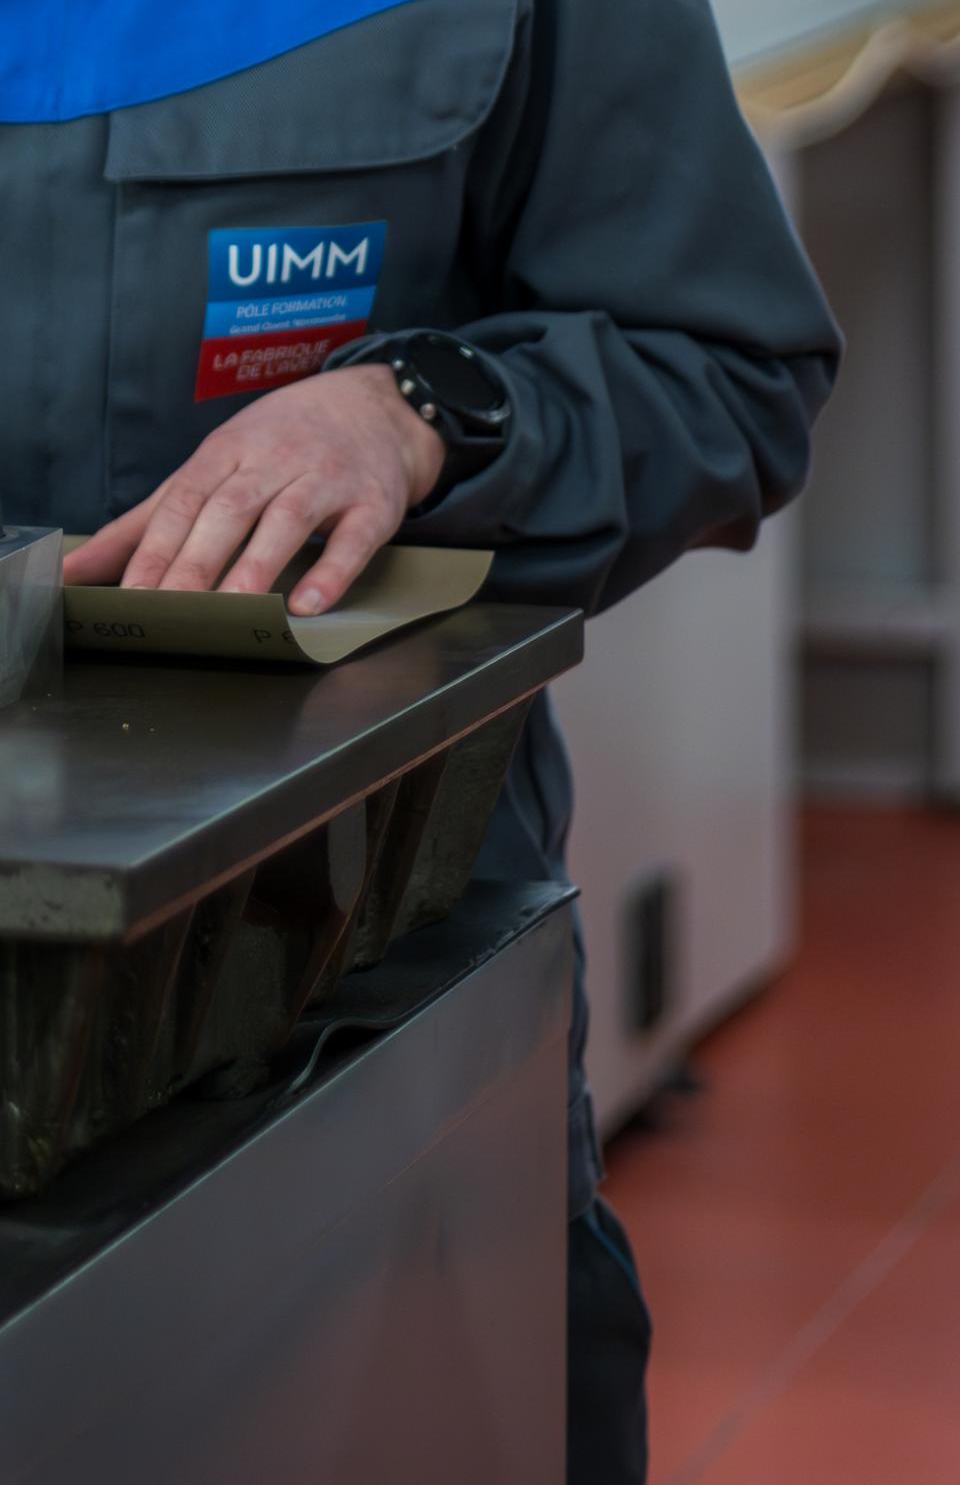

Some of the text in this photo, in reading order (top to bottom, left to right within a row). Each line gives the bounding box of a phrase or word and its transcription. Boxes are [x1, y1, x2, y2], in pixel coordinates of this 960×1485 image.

[228, 236, 369, 286] UIMM
[271, 295, 347, 315] FORMATION
[212, 338, 332, 370] LA FABRIQUE
[93, 621, 146, 639] 600
[252, 628, 272, 643] P
